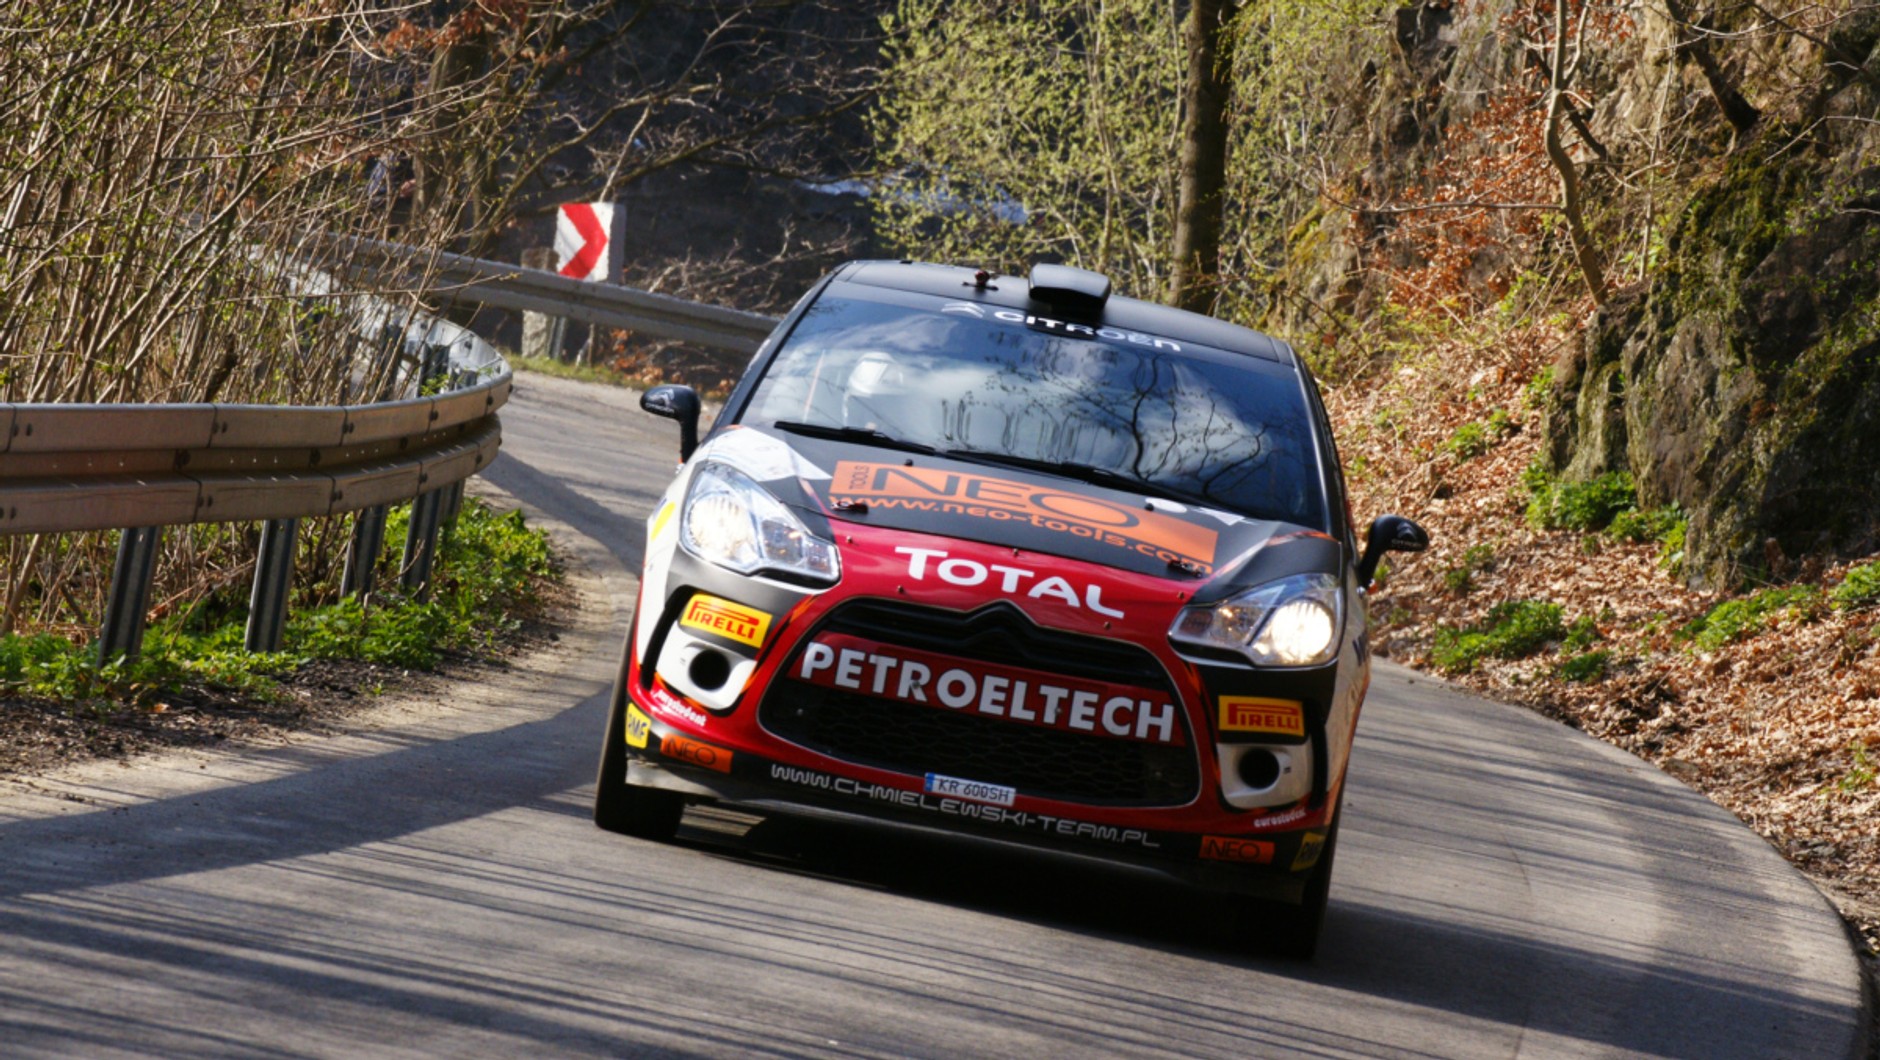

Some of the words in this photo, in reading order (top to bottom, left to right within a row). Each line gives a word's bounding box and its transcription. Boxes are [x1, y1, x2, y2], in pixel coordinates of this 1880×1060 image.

[849, 465, 870, 490] TOOLS
[872, 467, 1140, 529] NEO
[828, 495, 1214, 575] www.neo-tools.com
[894, 546, 1125, 620] TOTAL
[687, 600, 760, 640] PIRELLI
[800, 641, 1174, 743] PETROELTECH
[1227, 702, 1300, 731] PIRELLI
[666, 737, 717, 766] NEO
[770, 763, 1161, 848] WWW.CHMIELEWSKI-TEAM.PL
[938, 779, 960, 794] KR
[963, 783, 1010, 802] 600SH
[1207, 838, 1260, 860] NEO
